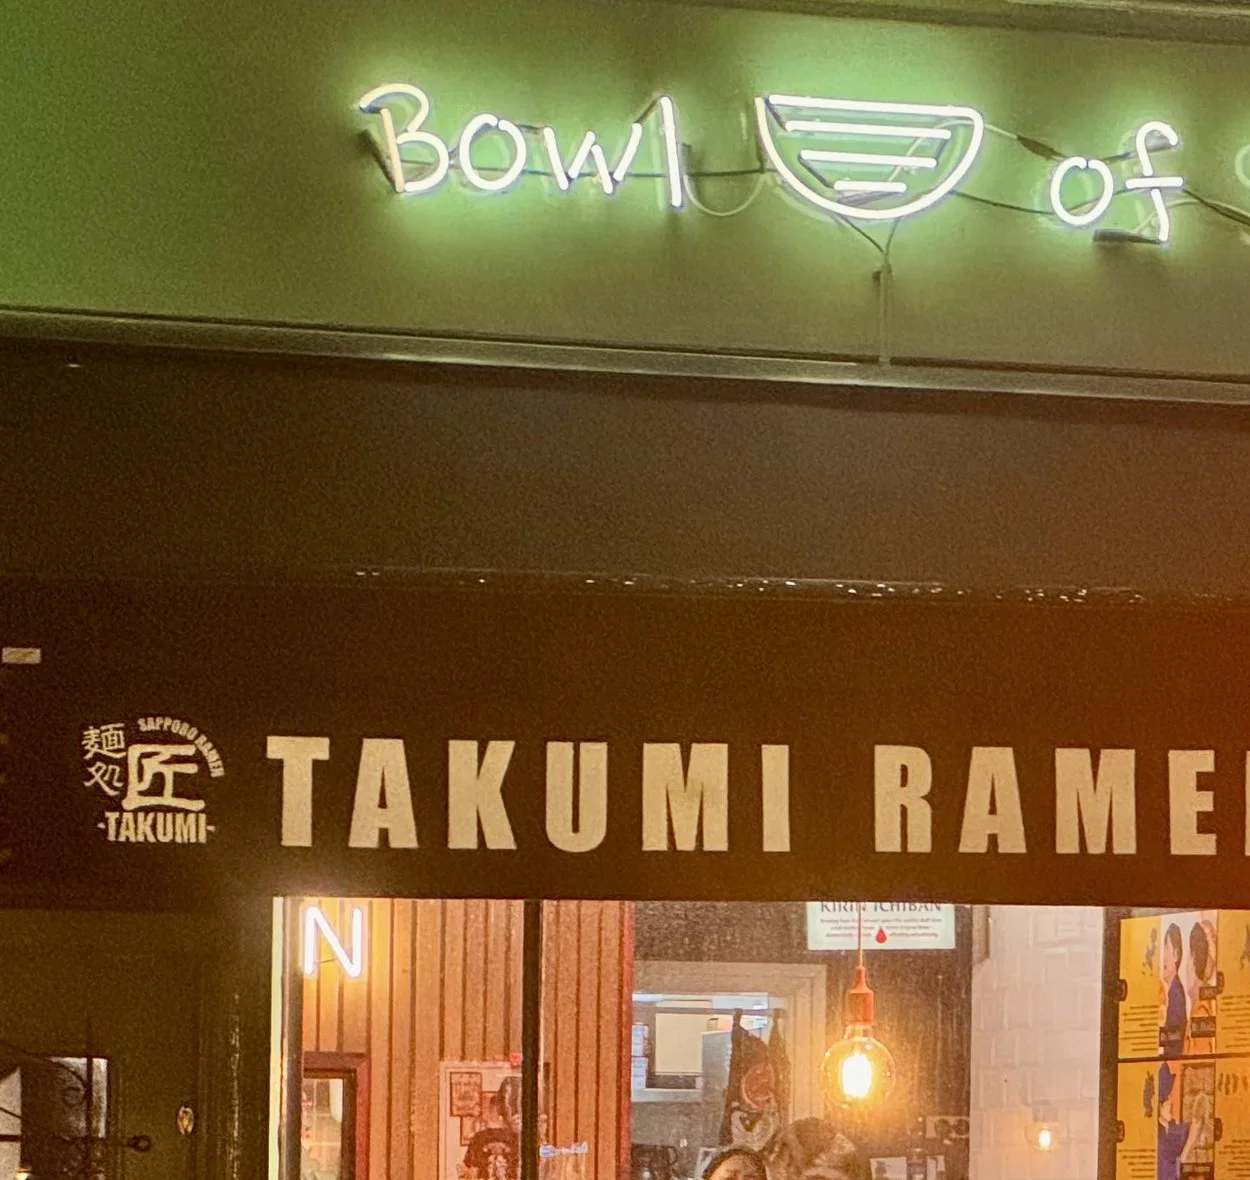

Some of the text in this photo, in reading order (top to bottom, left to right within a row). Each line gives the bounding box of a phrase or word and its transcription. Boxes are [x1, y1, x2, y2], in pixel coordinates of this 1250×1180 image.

[359, 83, 685, 212] Bowl
[1049, 121, 1186, 246] of
[121, 743, 206, 812] 匠
[137, 716, 225, 778] SAPPORO RAMEN
[266, 735, 792, 853] TAKUMI
